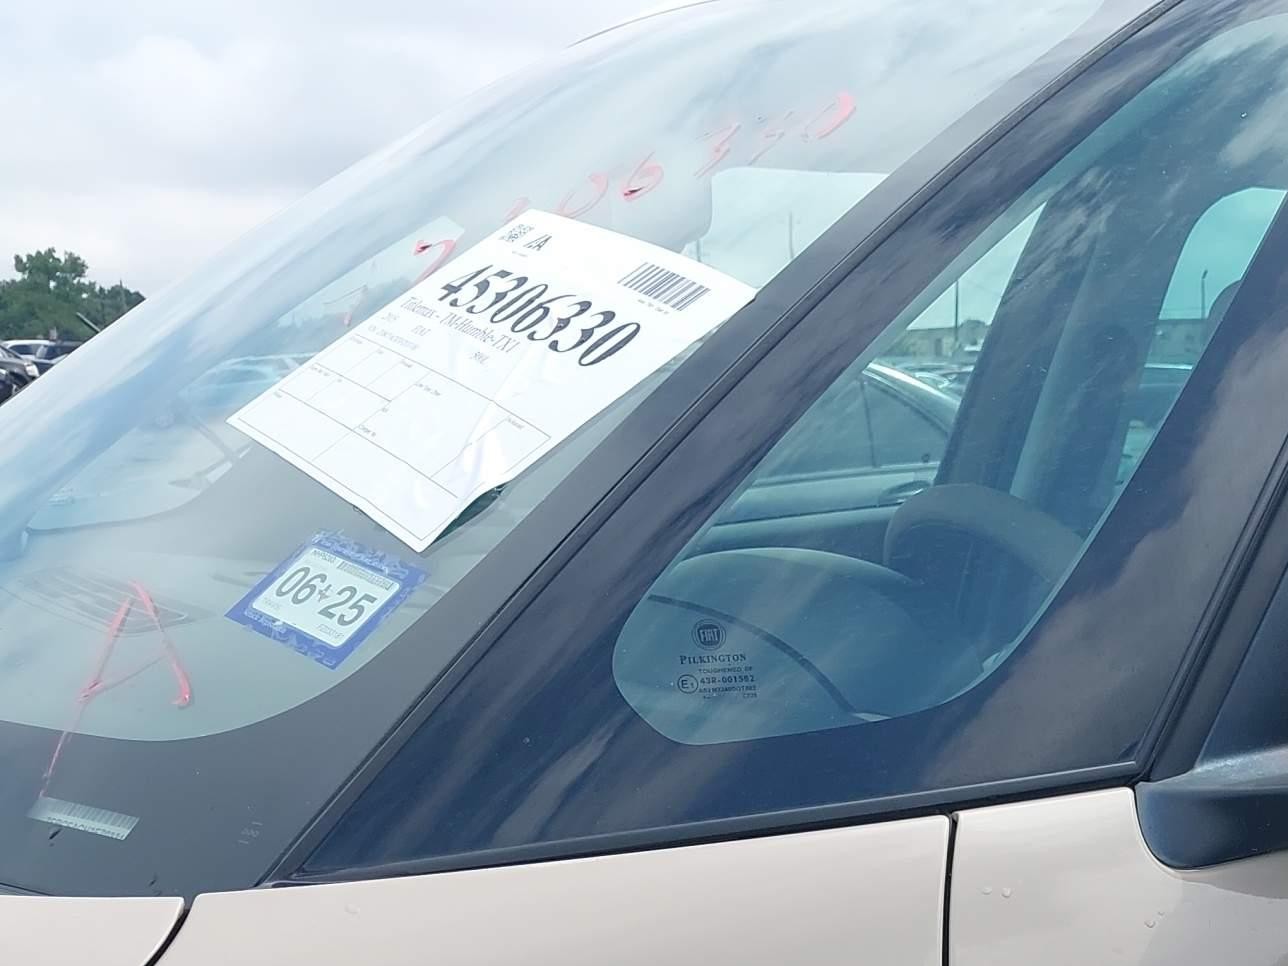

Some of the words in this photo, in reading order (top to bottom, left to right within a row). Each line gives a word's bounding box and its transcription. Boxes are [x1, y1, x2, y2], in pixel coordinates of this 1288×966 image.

[438, 264, 641, 366] 45306330
[275, 566, 328, 606] 06
[317, 585, 378, 627] 25
